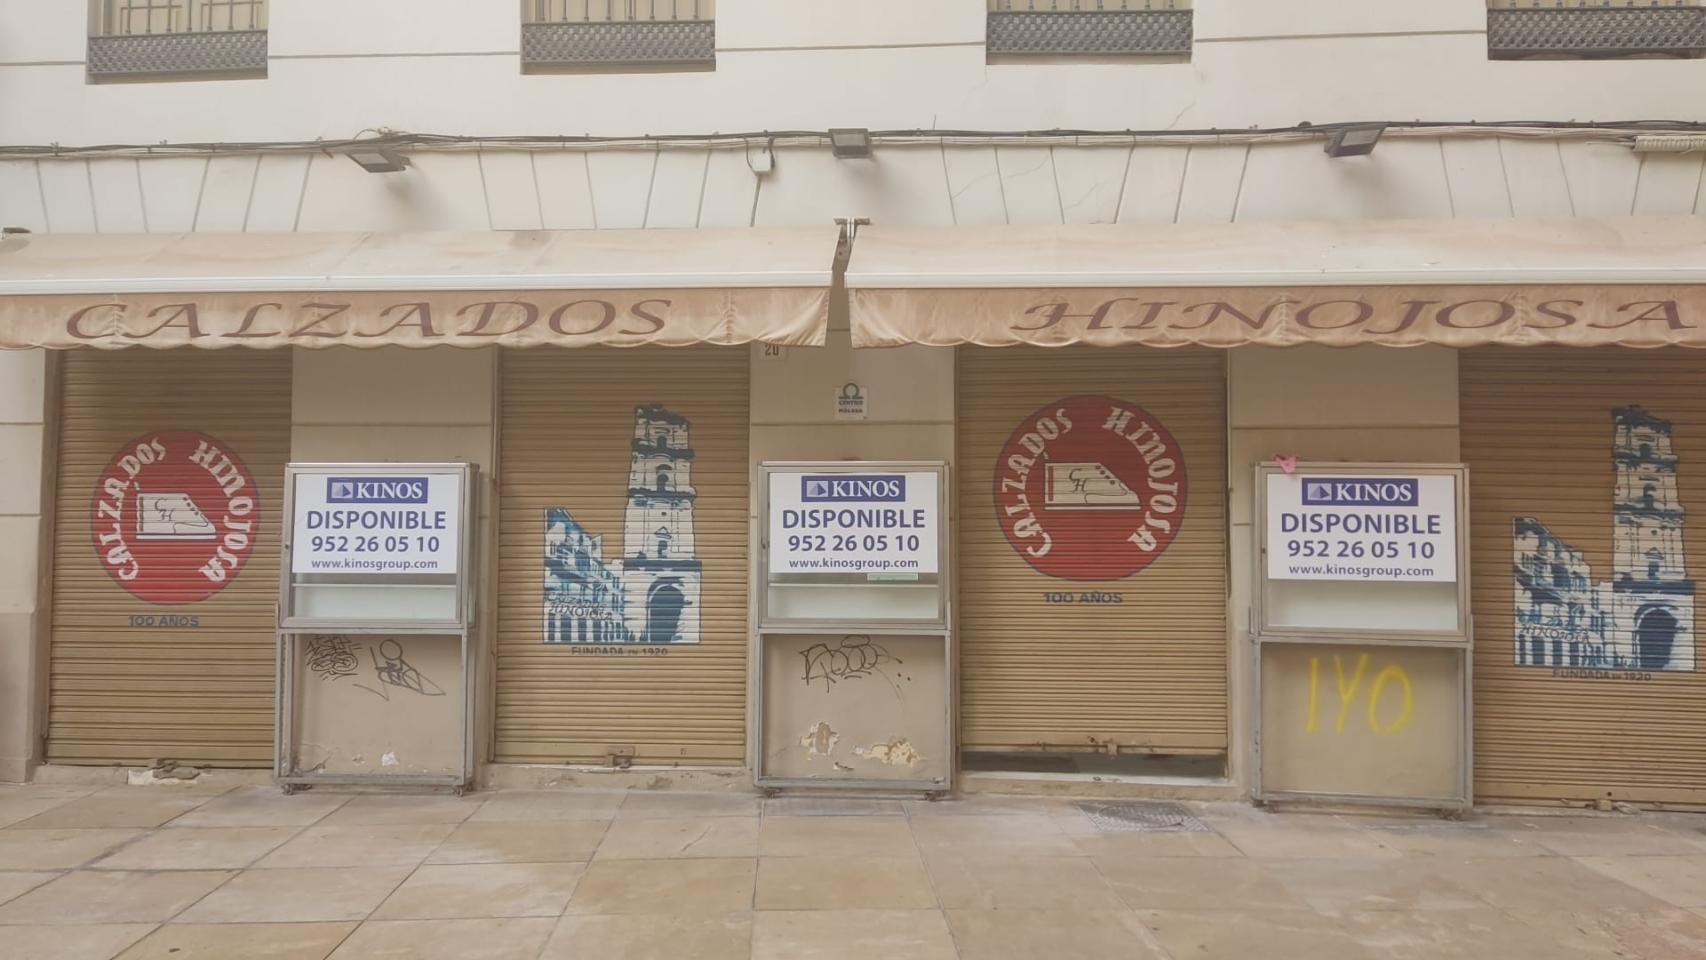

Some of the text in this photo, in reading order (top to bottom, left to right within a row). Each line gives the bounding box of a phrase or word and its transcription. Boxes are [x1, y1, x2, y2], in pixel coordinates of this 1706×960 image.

[66, 299, 672, 339] CALZADOS
[1009, 297, 1698, 334] HINOJOSA
[764, 343, 779, 356] 20
[356, 482, 423, 499] KINOS
[832, 480, 900, 498] KINOS
[1002, 406, 1179, 558] CALZADOS HINOJOSA
[1336, 483, 1412, 502] KINOS
[98, 436, 254, 582] CALZADOS HINOJOSA
[307, 510, 447, 530] DISPONIBLE
[782, 509, 926, 529] DISPONIBLE
[1281, 513, 1442, 535] DISPONIBLE
[312, 536, 439, 552] 952 26 05 10
[788, 535, 920, 552] 952 26 05 10
[1288, 540, 1435, 559] 952 26 05 10
[311, 558, 438, 571] www.kinosgroup.com
[789, 557, 919, 570] www.kinosgroup.com
[1289, 563, 1434, 578] www.kinosgroup.com
[1044, 589, 1123, 603] 100 AÑOS
[129, 616, 154, 627] 100
[571, 646, 624, 656] FUNDADA
[643, 648, 669, 656] 1920
[1552, 668, 1612, 680] FUNDADA
[1624, 672, 1653, 682] 1920
